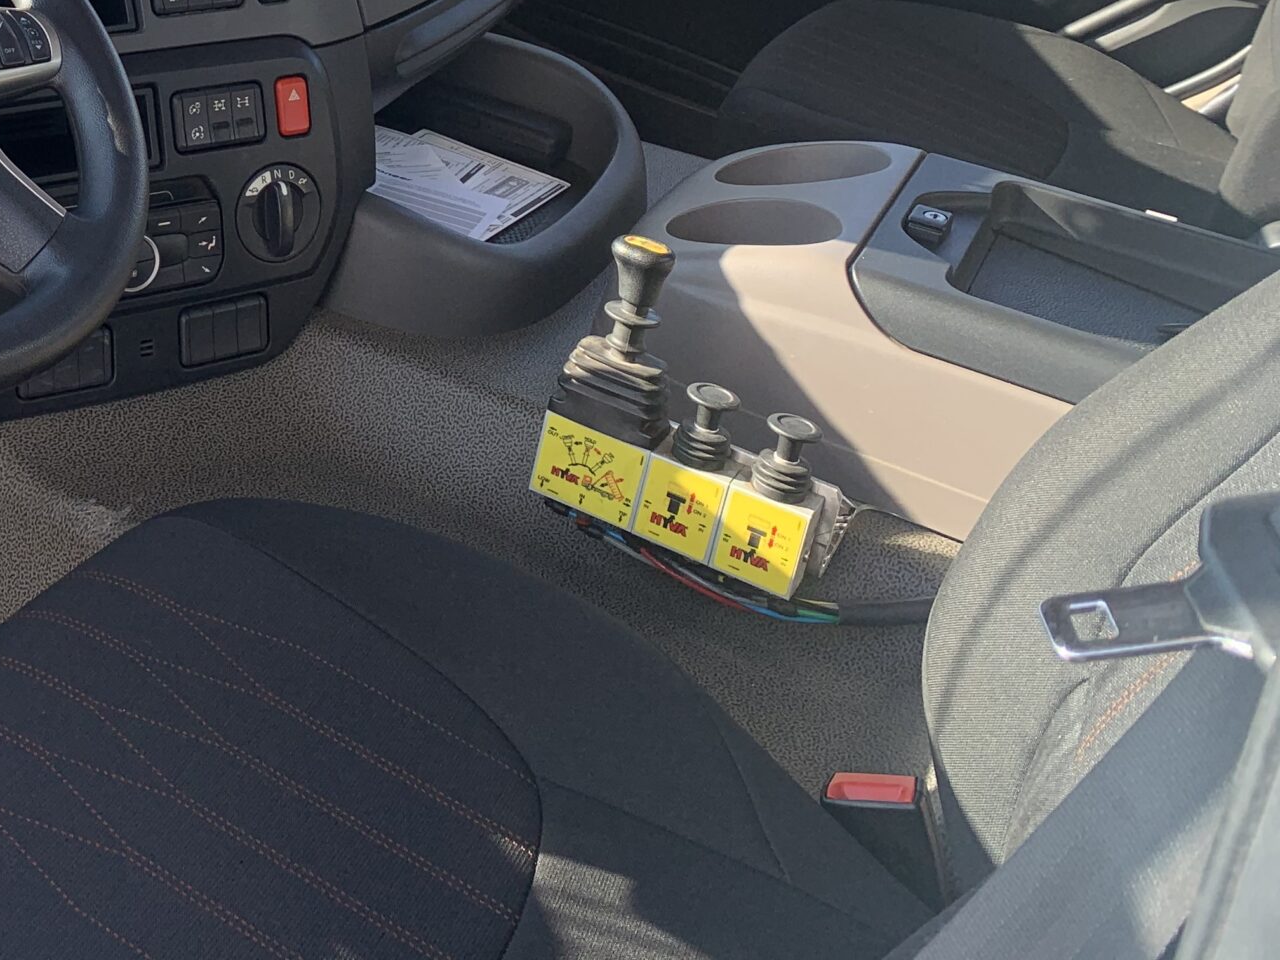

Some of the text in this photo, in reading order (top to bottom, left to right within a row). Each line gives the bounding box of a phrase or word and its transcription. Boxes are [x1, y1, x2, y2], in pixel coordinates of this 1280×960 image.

[262, 169, 295, 184] R N D
[550, 466, 580, 486] HYVA
[650, 512, 688, 538] HYVA
[730, 545, 770, 572] HYVA
